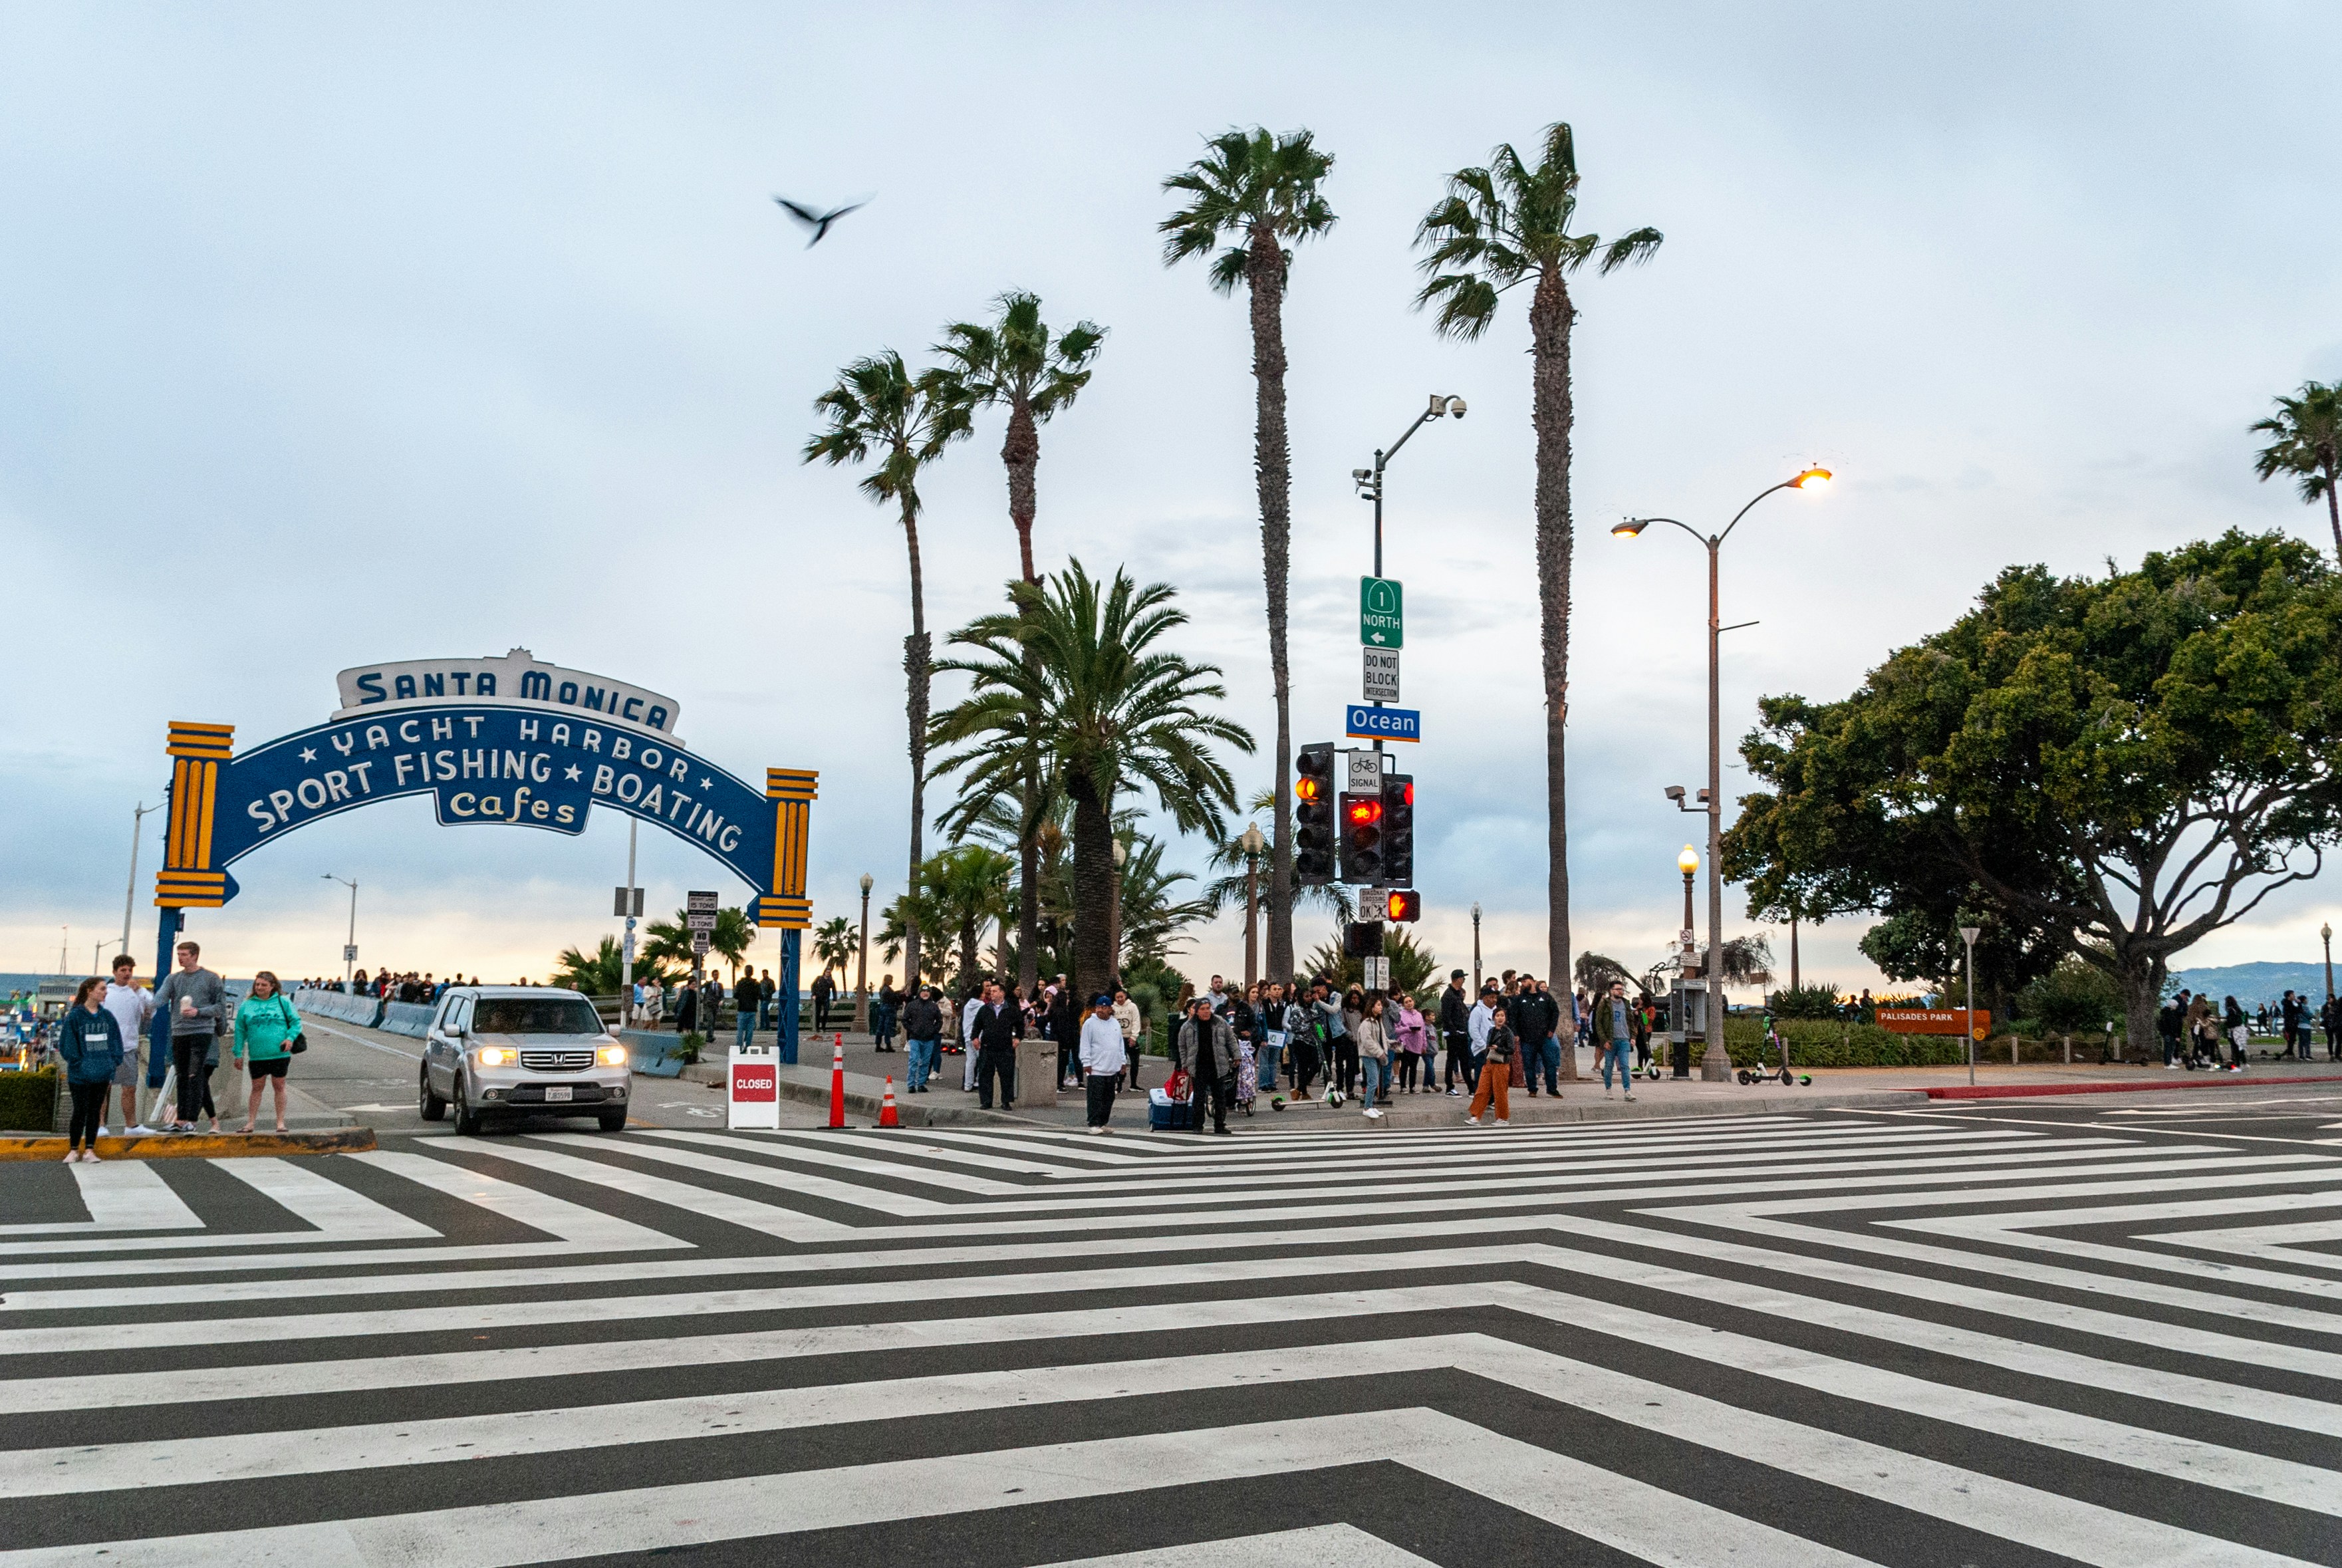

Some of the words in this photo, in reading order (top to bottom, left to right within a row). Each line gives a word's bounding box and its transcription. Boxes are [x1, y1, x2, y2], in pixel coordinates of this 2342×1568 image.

[1379, 591, 1384, 606] 1
[1363, 613, 1400, 630] NORTH
[1366, 654, 1378, 667] DO
[1380, 656, 1397, 669] NOT
[1366, 672, 1397, 686] BLOCK
[356, 672, 497, 705] SANTA
[521, 670, 668, 730] MONICA
[1365, 687, 1397, 698] INTERSECTION
[1353, 710, 1414, 731] Ocean
[331, 716, 485, 756] YACHT
[519, 719, 688, 783] HARBOR
[1351, 778, 1378, 787] SIGNAL
[247, 761, 372, 833] SPORT
[394, 749, 551, 786] FISHING
[592, 764, 742, 852] BOATING
[1360, 905, 1371, 918] OK
[736, 1079, 773, 1089] CLOSED
